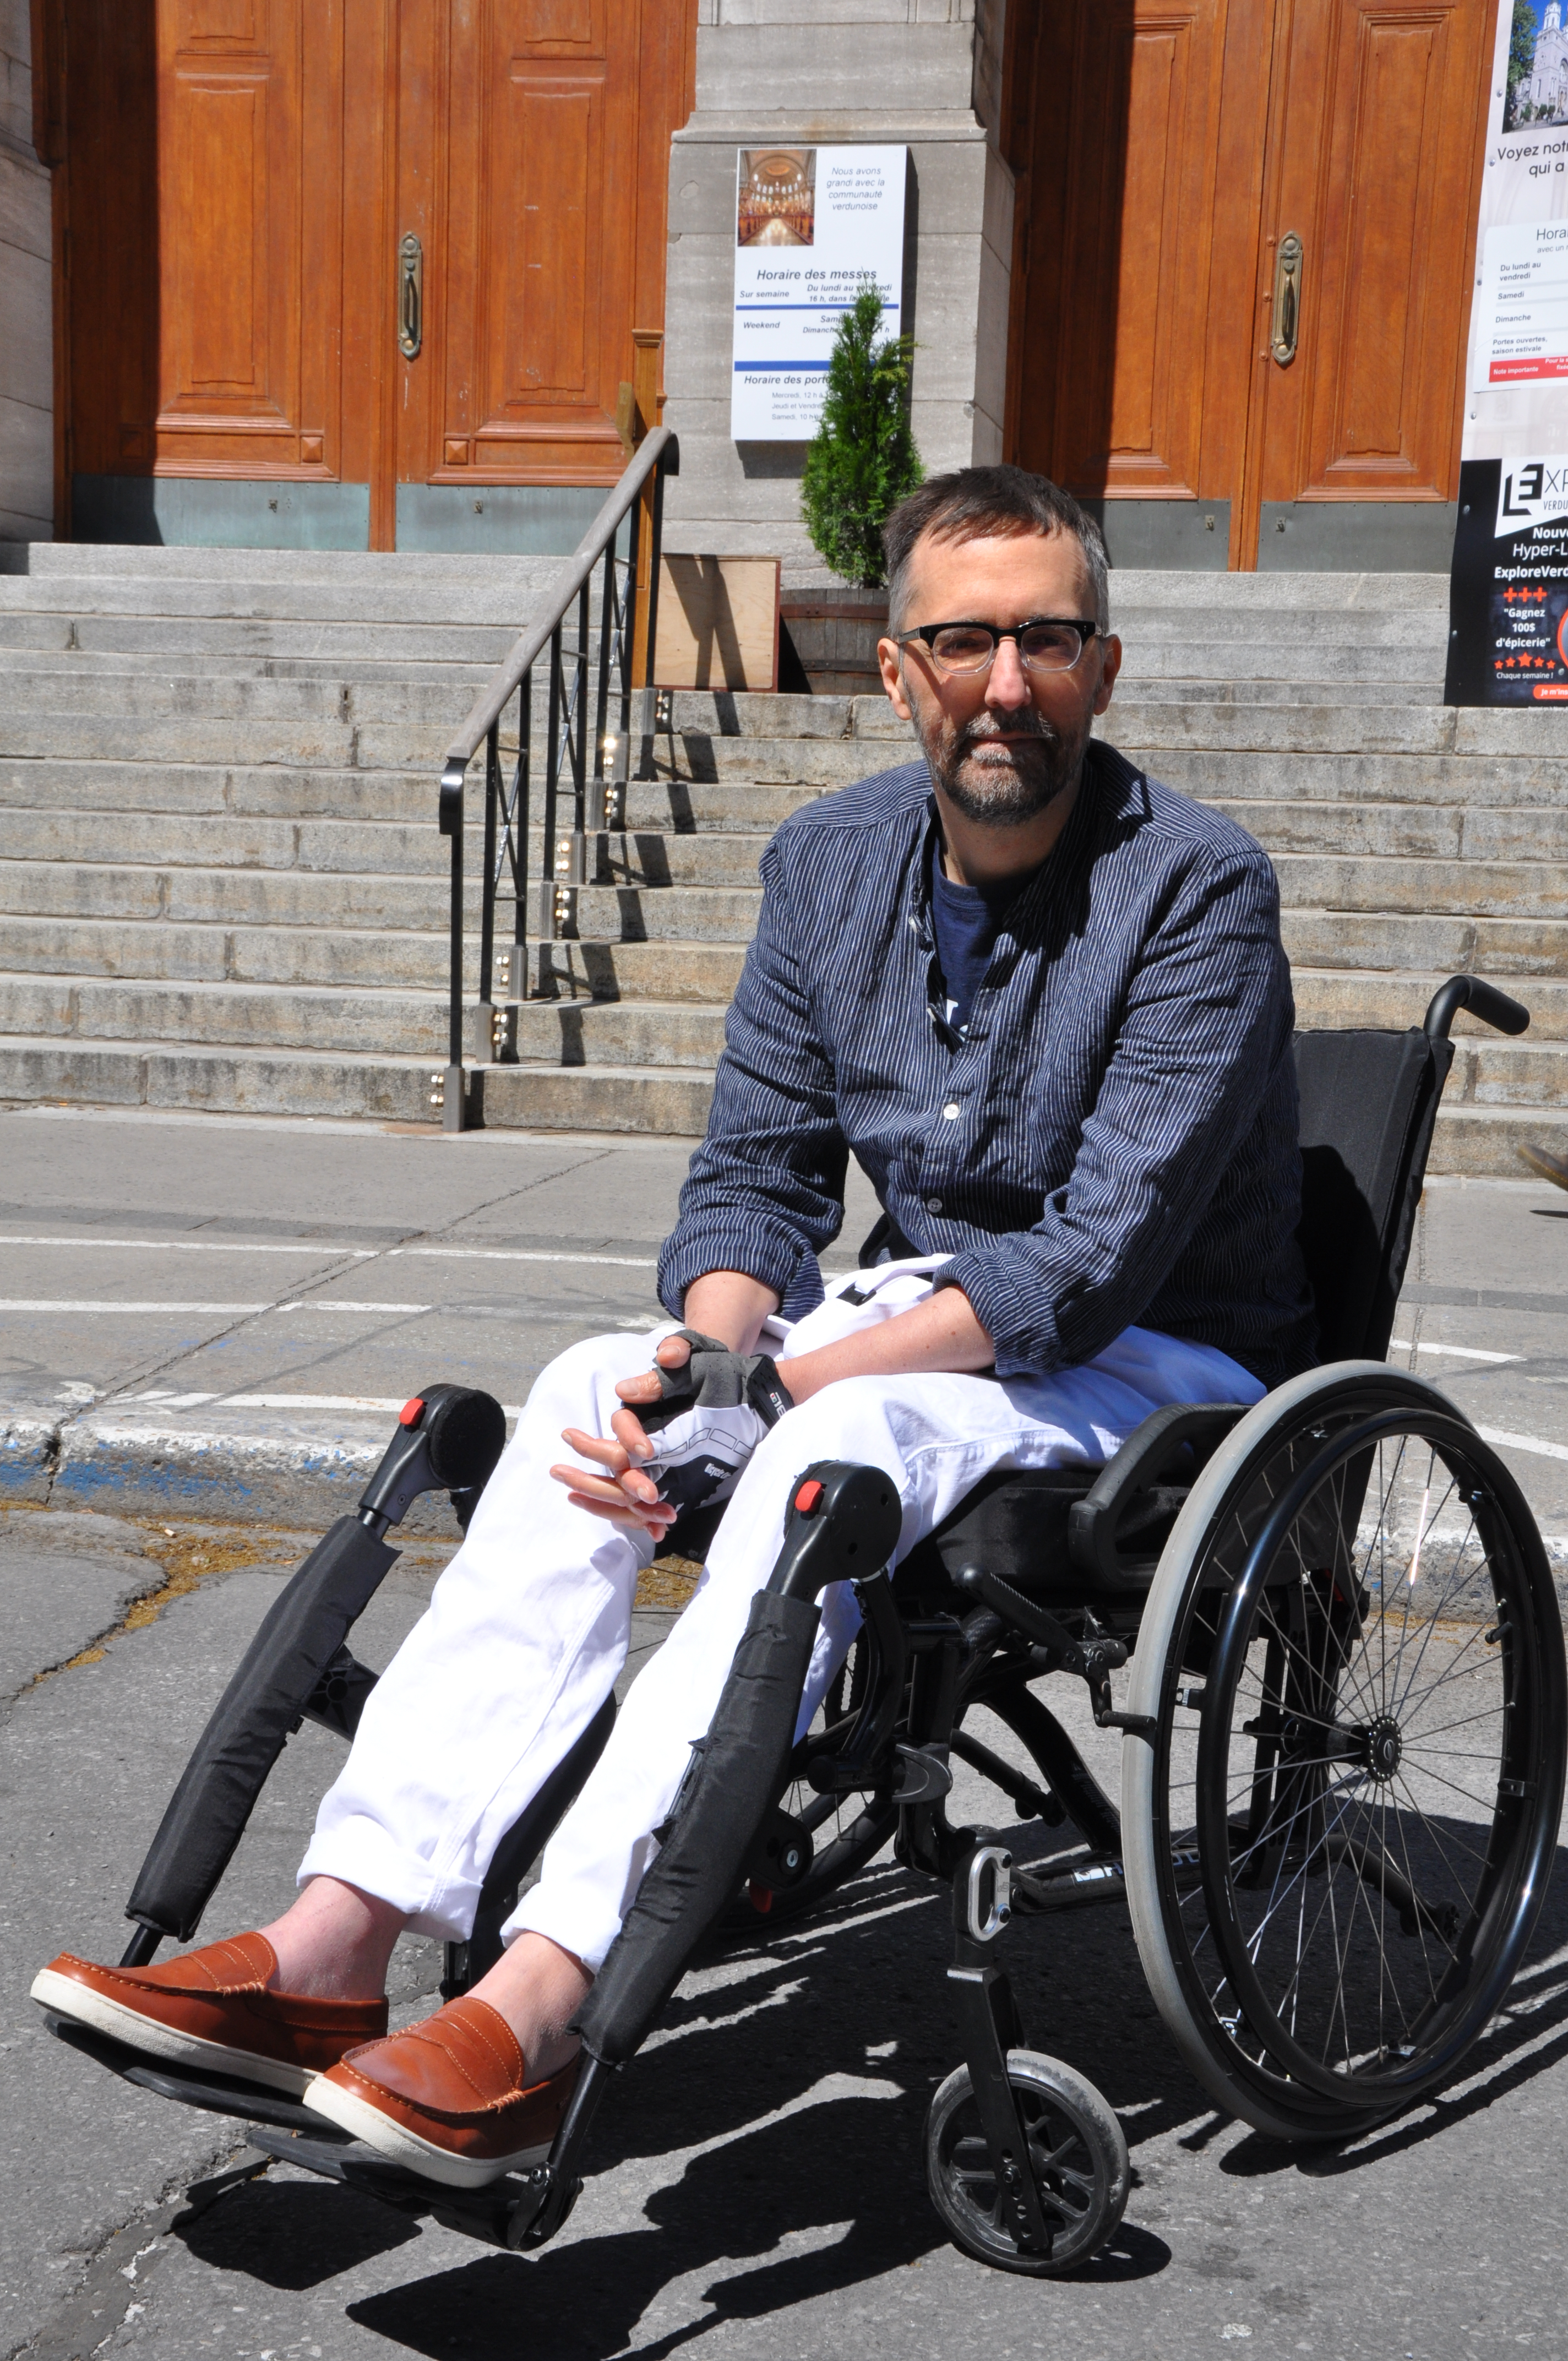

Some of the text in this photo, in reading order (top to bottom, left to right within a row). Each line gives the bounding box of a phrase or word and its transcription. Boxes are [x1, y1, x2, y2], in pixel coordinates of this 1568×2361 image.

[1498, 146, 1539, 161] Voyez
[832, 167, 853, 175] Nous
[1529, 161, 1565, 178] qui a
[826, 179, 852, 188] grandi
[829, 191, 883, 199] communauté
[832, 202, 878, 210] verdunoise
[757, 269, 877, 280] Horaire des messes
[1500, 272, 1531, 281] vendredi
[1498, 291, 1525, 300] Samedi
[1495, 314, 1531, 323] Dimanche
[744, 376, 781, 384] Horaire
[784, 376, 801, 384] des
[1512, 541, 1568, 561] Hyper-L
[1504, 608, 1545, 620] "Gagnez
[1512, 623, 1536, 633] 100$
[1495, 637, 1551, 650] d'épicerie"
[1496, 672, 1521, 681] Chaque
